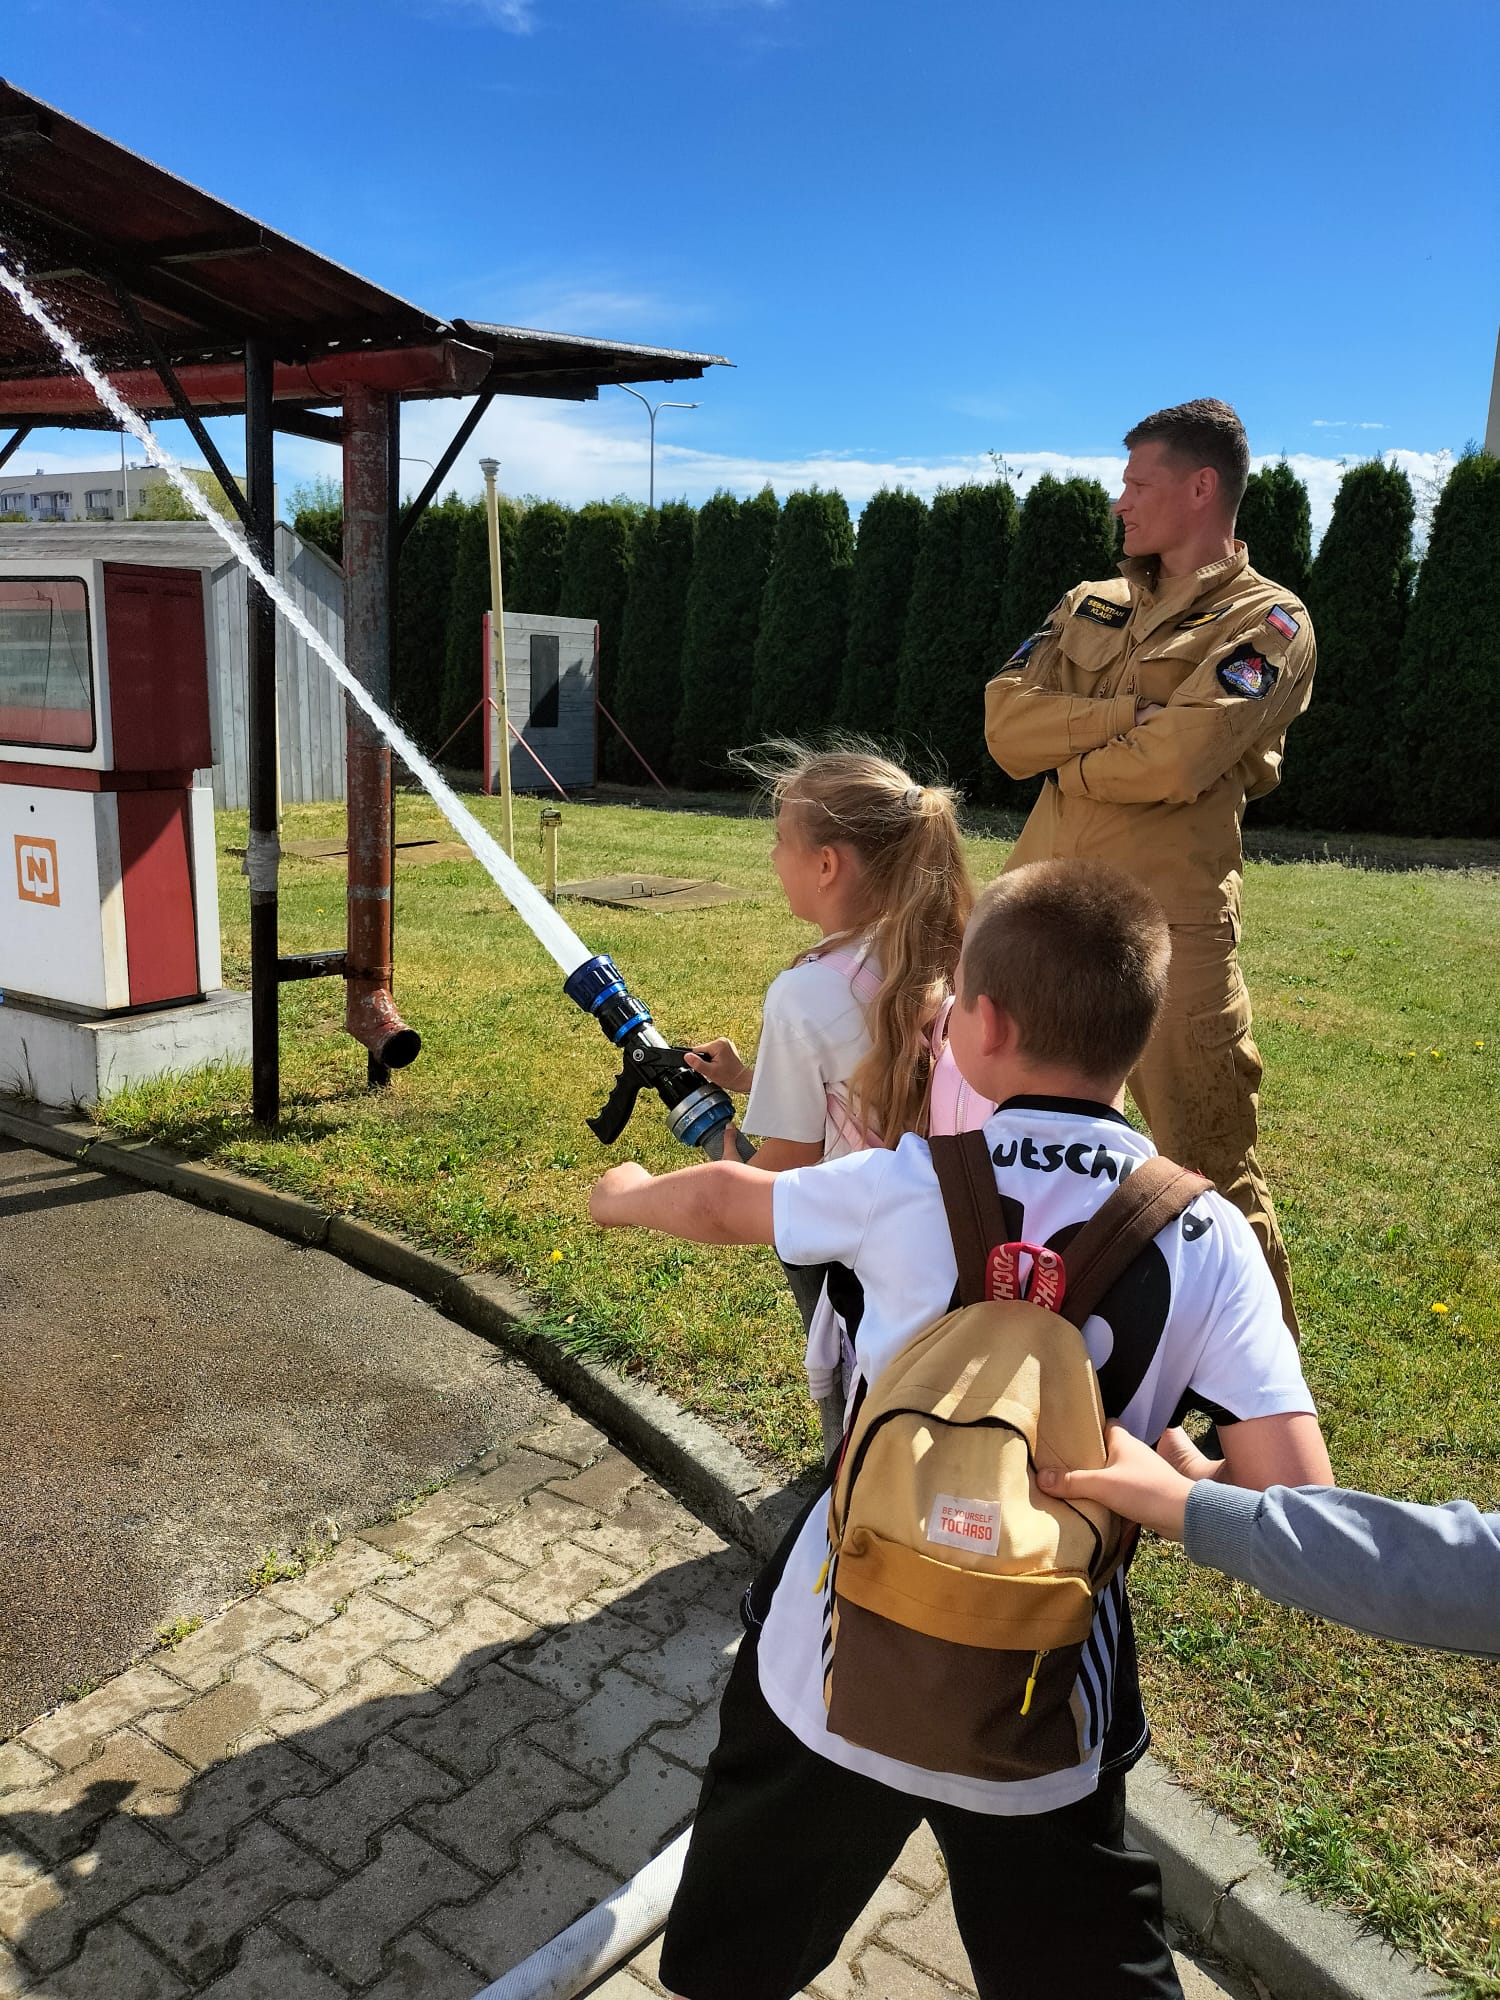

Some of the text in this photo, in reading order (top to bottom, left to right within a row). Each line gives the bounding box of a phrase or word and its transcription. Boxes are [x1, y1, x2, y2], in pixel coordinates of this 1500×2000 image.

[992, 1244, 1014, 1301] TOCH
[942, 1506, 993, 1523] BE YOURSELF
[941, 1517, 993, 1540] TOCHASO
